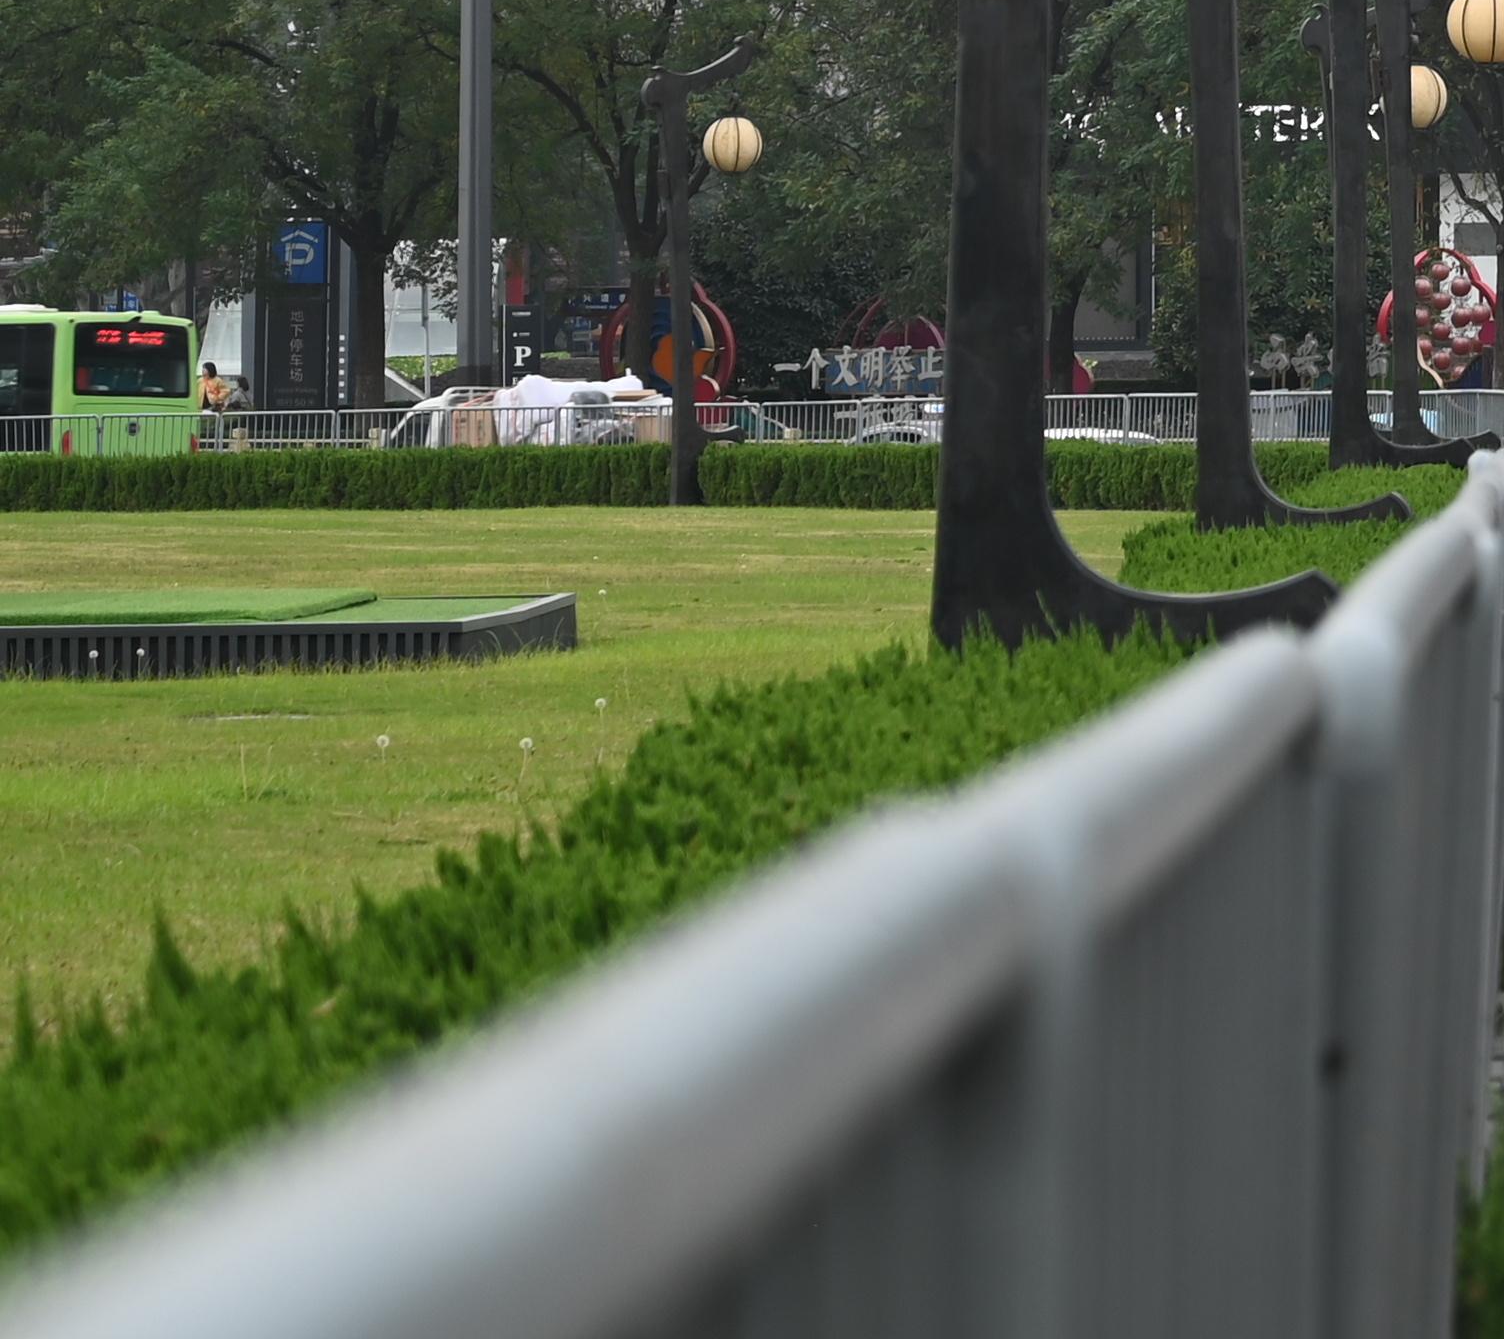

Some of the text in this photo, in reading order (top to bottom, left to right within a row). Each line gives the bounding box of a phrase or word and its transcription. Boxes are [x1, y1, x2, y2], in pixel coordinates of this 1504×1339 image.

[289, 310, 305, 383] 地下停车场
[513, 346, 532, 367] P
